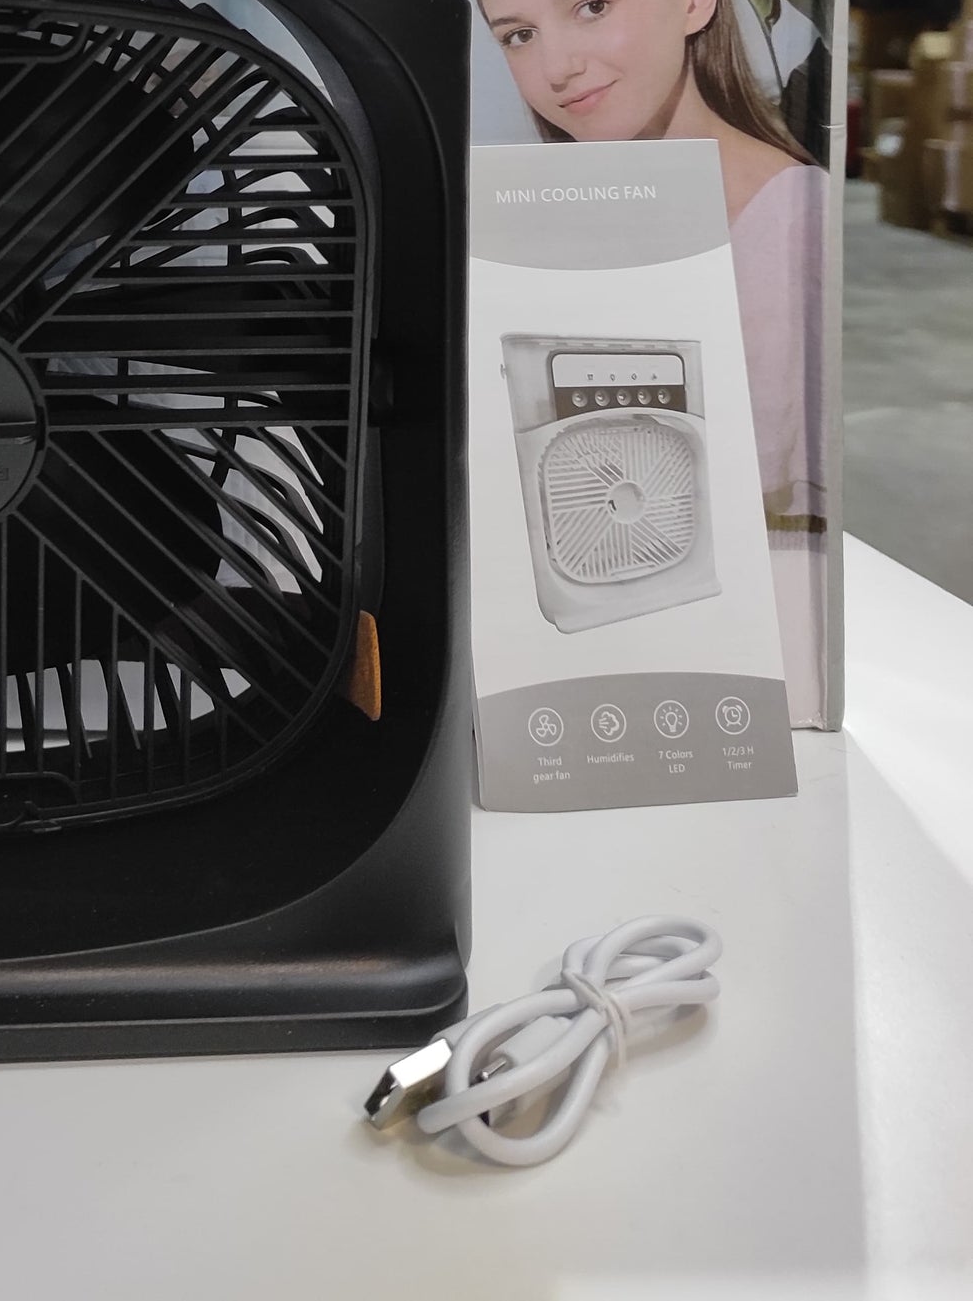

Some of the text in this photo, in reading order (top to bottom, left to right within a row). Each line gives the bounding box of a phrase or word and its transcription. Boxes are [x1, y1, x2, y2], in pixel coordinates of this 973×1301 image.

[495, 185, 657, 204] MINI COOLING FAN
[665, 750, 693, 759] Colors
[747, 745, 754, 755] H
[538, 755, 562, 766] Third
[728, 760, 752, 770] Timer
[668, 763, 685, 773] LED
[533, 770, 570, 784] gear fan
